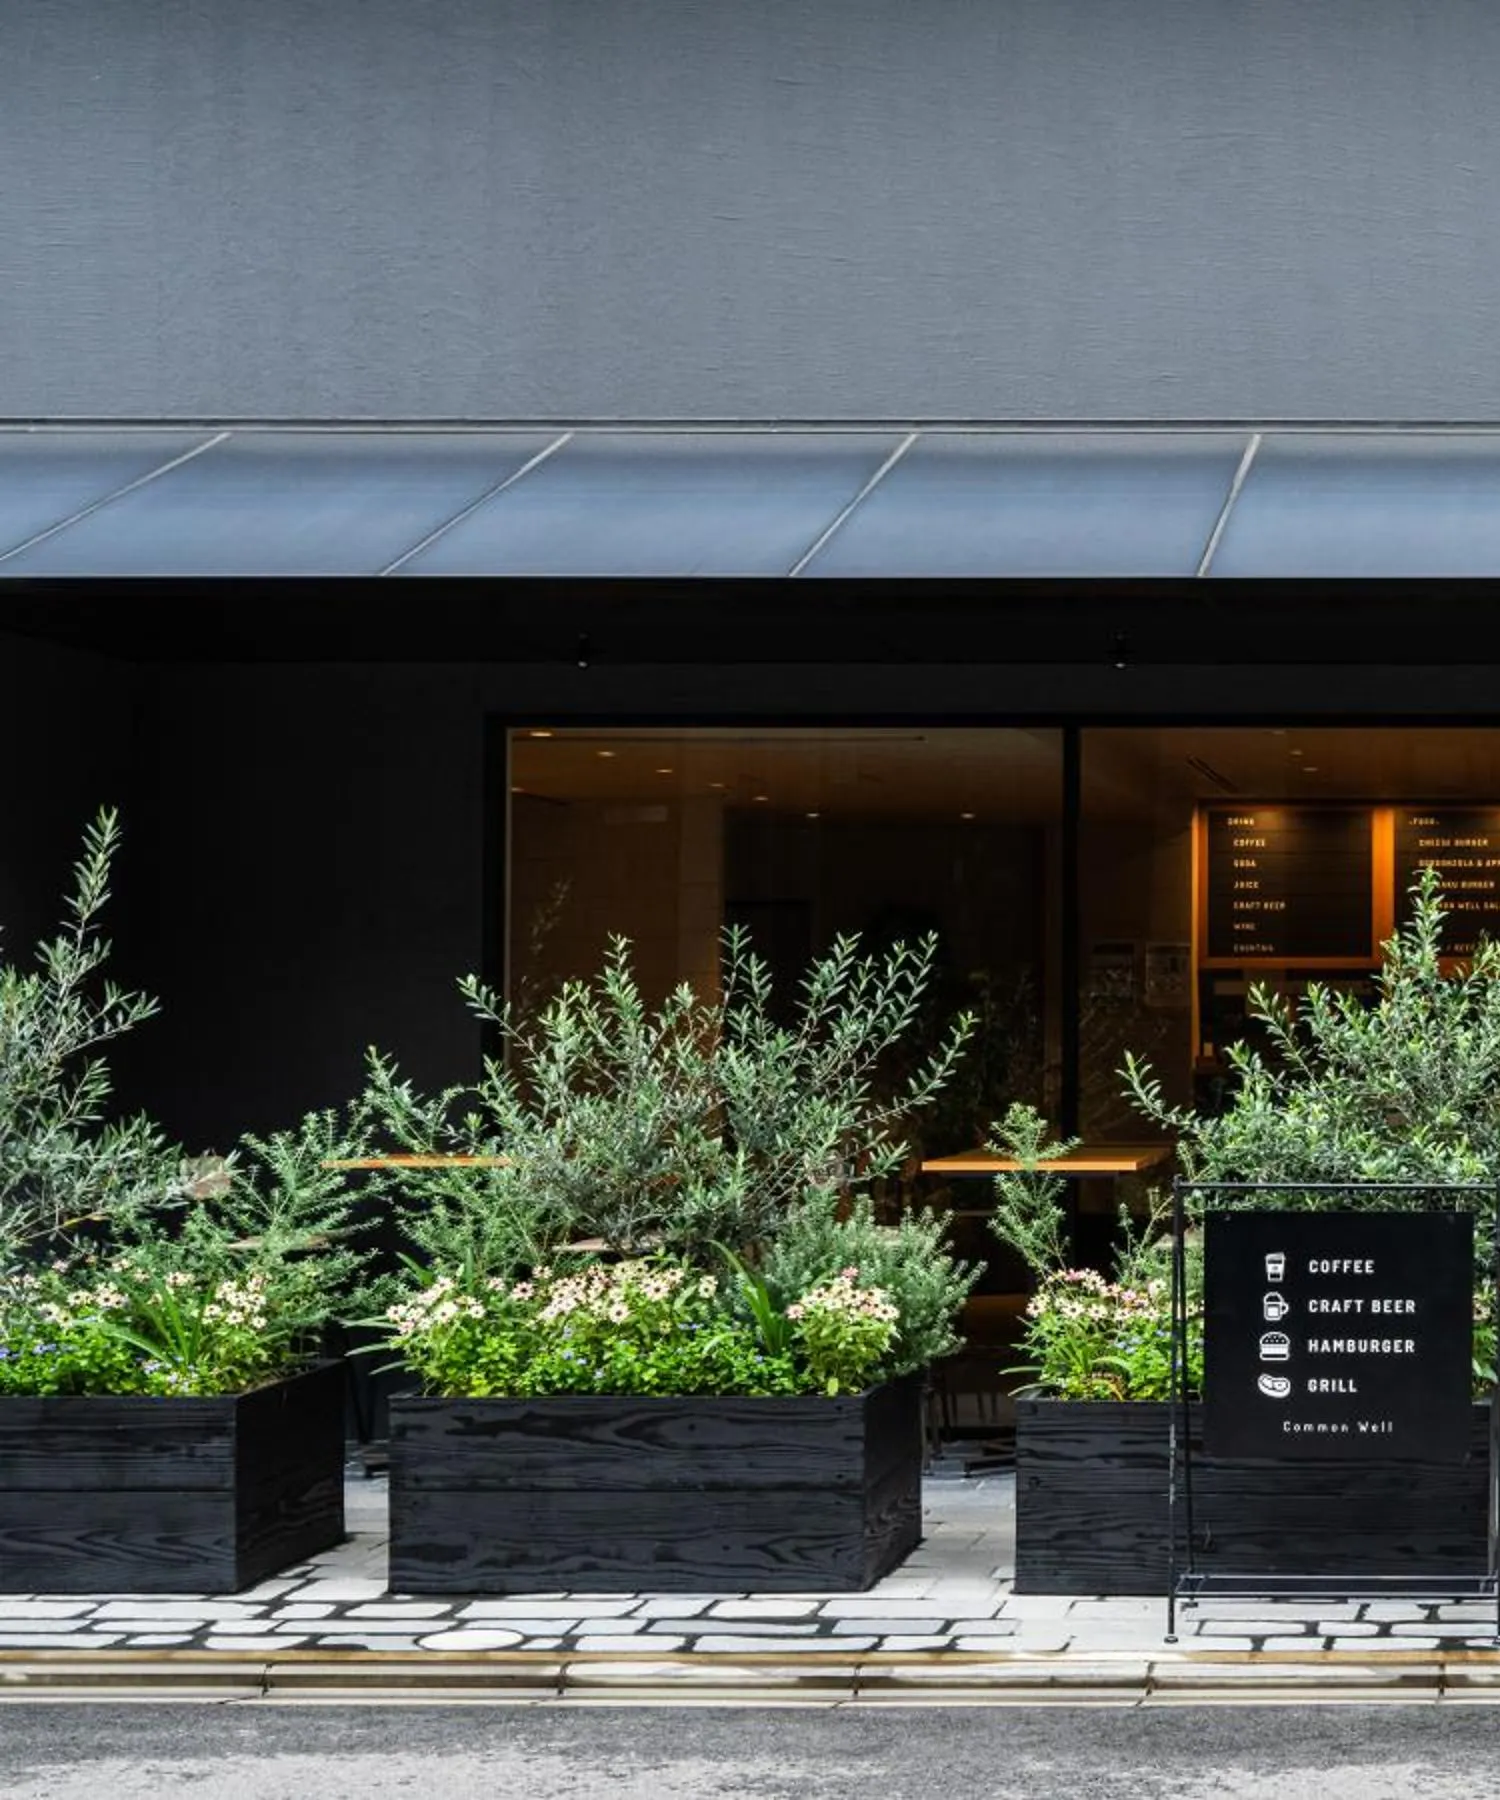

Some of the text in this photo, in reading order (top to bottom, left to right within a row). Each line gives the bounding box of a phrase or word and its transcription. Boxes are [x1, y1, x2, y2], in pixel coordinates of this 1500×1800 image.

[1308, 1259, 1375, 1274] COFFEE
[1308, 1299, 1416, 1313] CRAFT BEER
[1307, 1339, 1415, 1354] HAMBURGER
[1307, 1379, 1358, 1393] GRILL
[1283, 1421, 1393, 1433] Common Well
